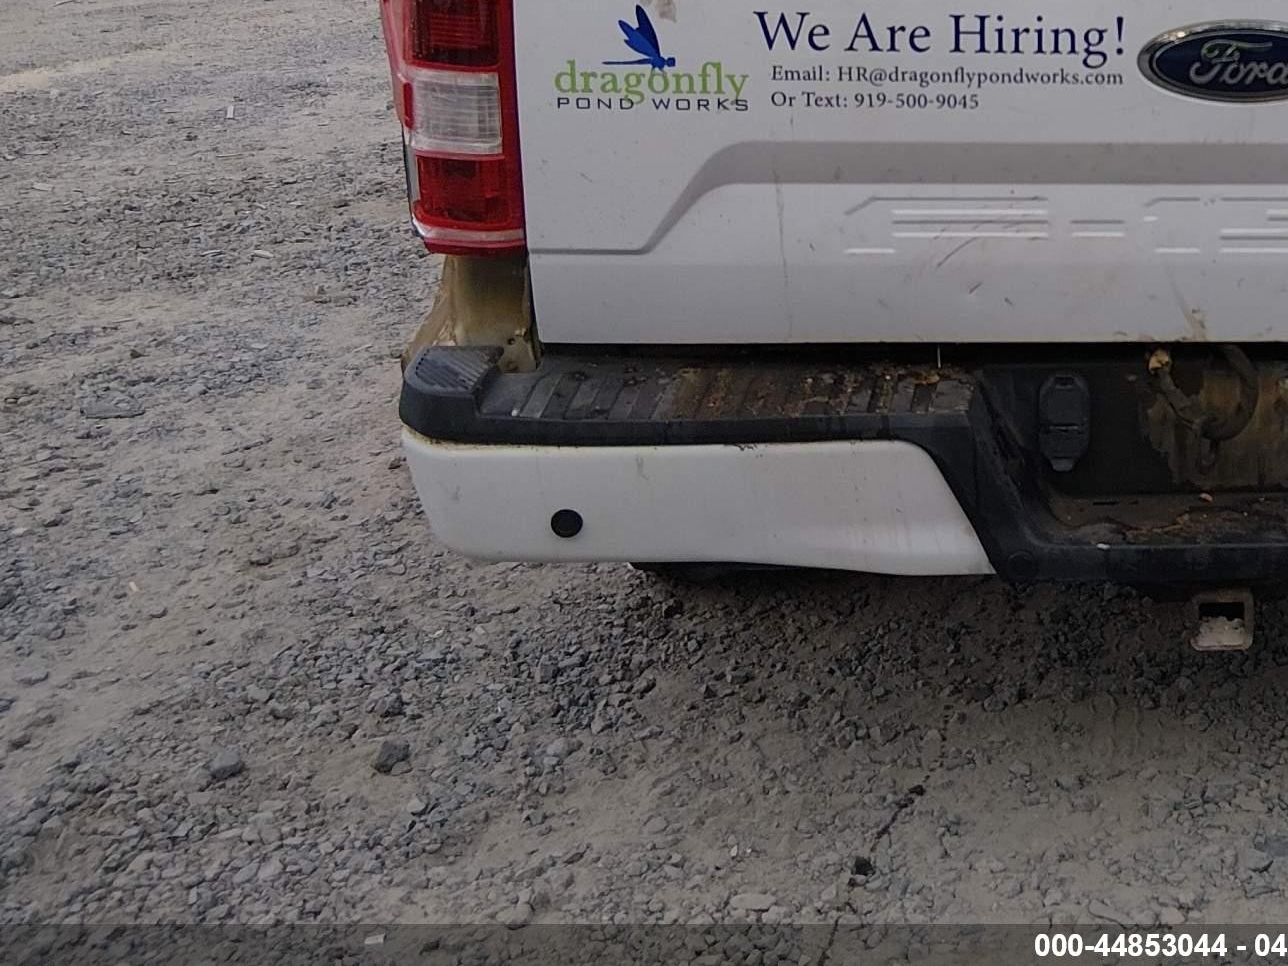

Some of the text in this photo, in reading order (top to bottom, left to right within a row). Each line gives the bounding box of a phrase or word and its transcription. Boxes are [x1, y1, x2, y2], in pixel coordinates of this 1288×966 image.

[752, 10, 1125, 68] We Are Hiring!
[554, 58, 750, 105] dragonfly
[771, 65, 1124, 88] Email: HR@dragonflypondworks.com
[556, 97, 750, 112] POND WORKS
[770, 91, 982, 111] Or Text: 919-500-9045
